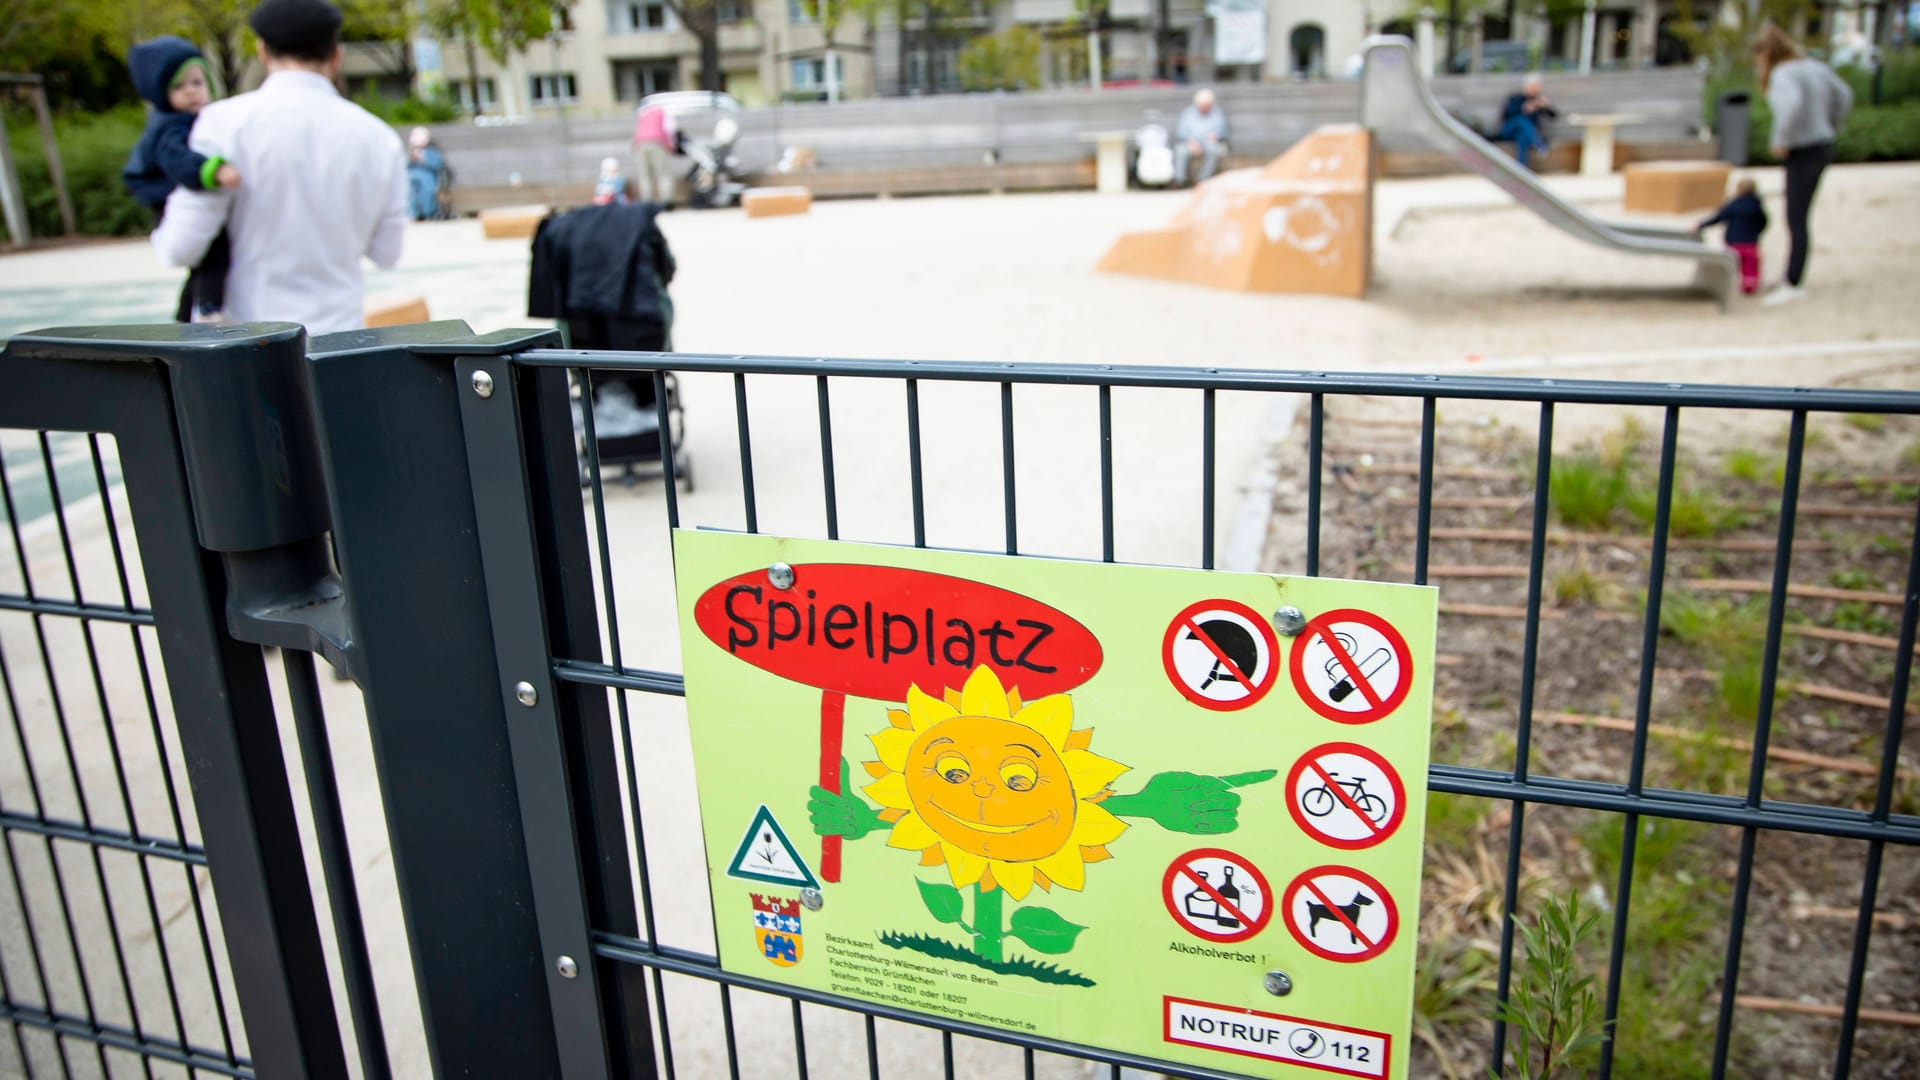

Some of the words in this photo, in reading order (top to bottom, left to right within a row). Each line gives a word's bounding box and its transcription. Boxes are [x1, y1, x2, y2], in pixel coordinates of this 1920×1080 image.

[725, 584, 1058, 674] Spielplatz
[825, 933, 874, 950] Bezirksamt
[1169, 941, 1256, 964] Alkoholverbot
[826, 945, 949, 977] Charlottenburg-Wilmersdorf
[952, 971, 967, 981] von
[971, 974, 998, 986] Berlin
[829, 957, 881, 975] Fachbereich
[883, 967, 936, 986] Grünflächen
[831, 983, 1037, 1031] gruenflaechen@charlottenburg-wilmersdorf.de
[864, 977, 884, 988] 9029
[893, 983, 917, 995] 18201
[920, 988, 939, 999] oder
[942, 992, 967, 1004] 18207
[1180, 1014, 1281, 1046] NOTRUF
[1330, 1042, 1371, 1063] 112
